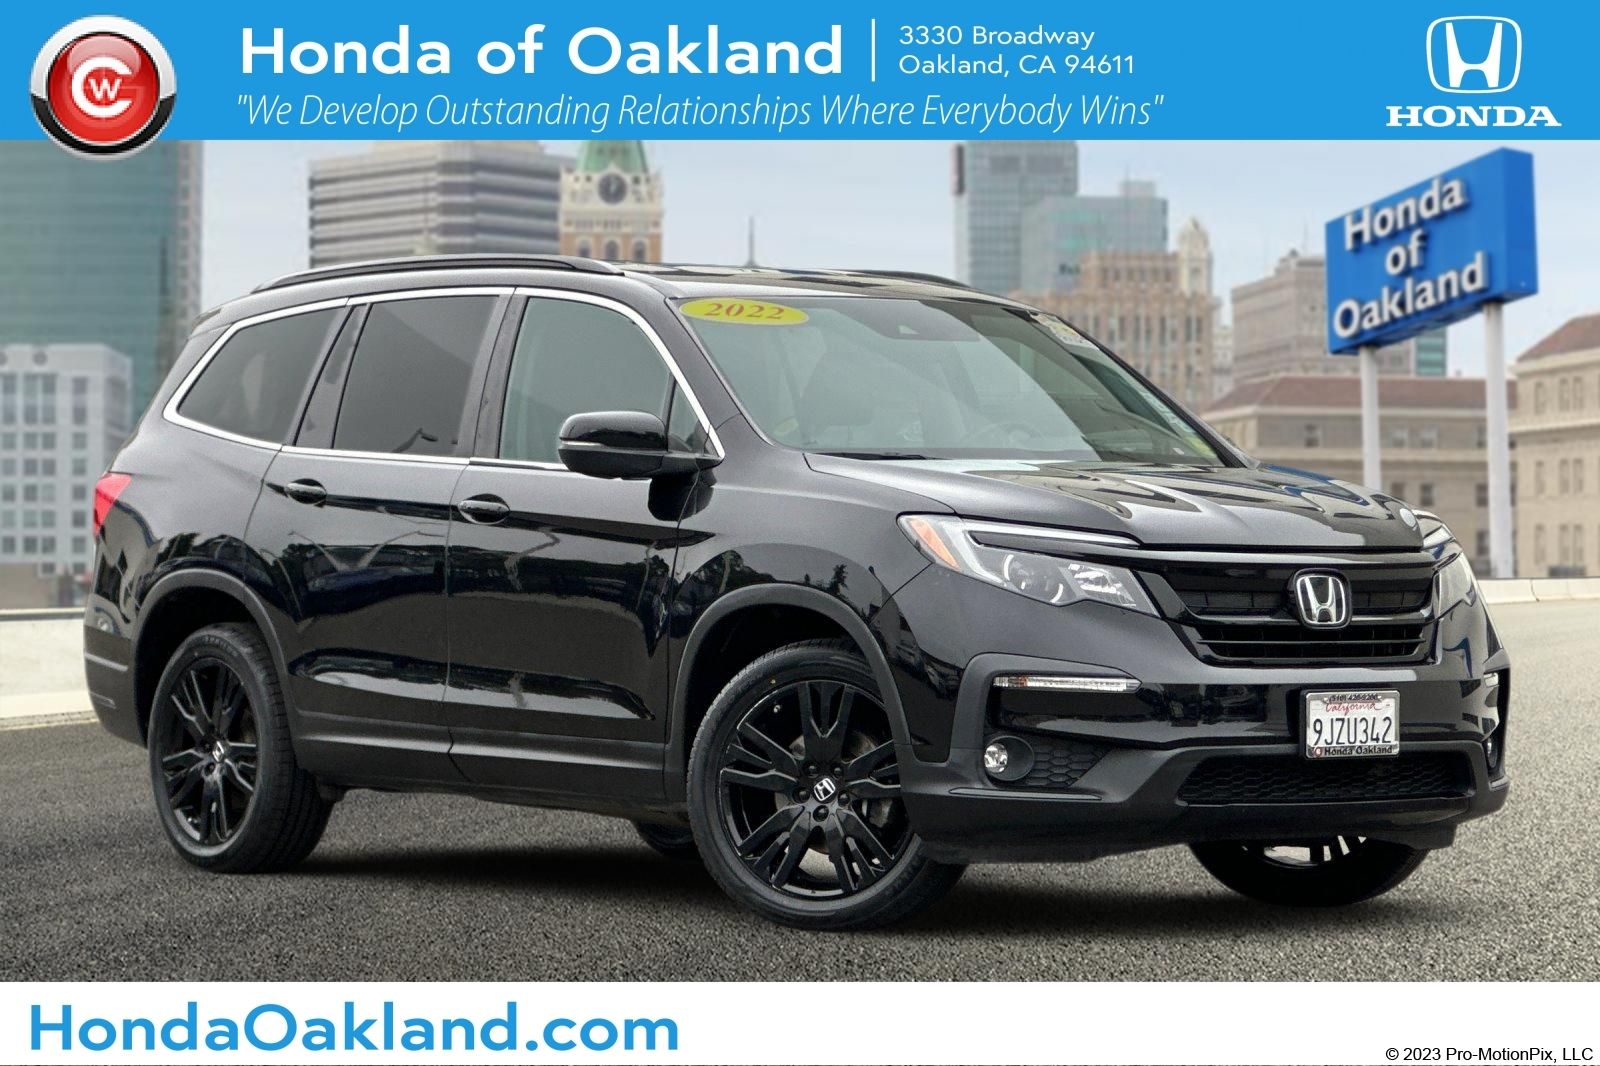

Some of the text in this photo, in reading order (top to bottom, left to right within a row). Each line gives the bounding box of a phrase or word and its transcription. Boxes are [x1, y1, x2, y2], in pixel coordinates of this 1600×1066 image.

[1344, 173, 1467, 251] Honda
[1385, 229, 1427, 276] of
[703, 302, 785, 320] 2022
[1333, 251, 1489, 338] Oakland
[1312, 716, 1392, 746] 9JZU342
[1324, 746, 1353, 755] Honda
[1355, 745, 1393, 755] Oakland
